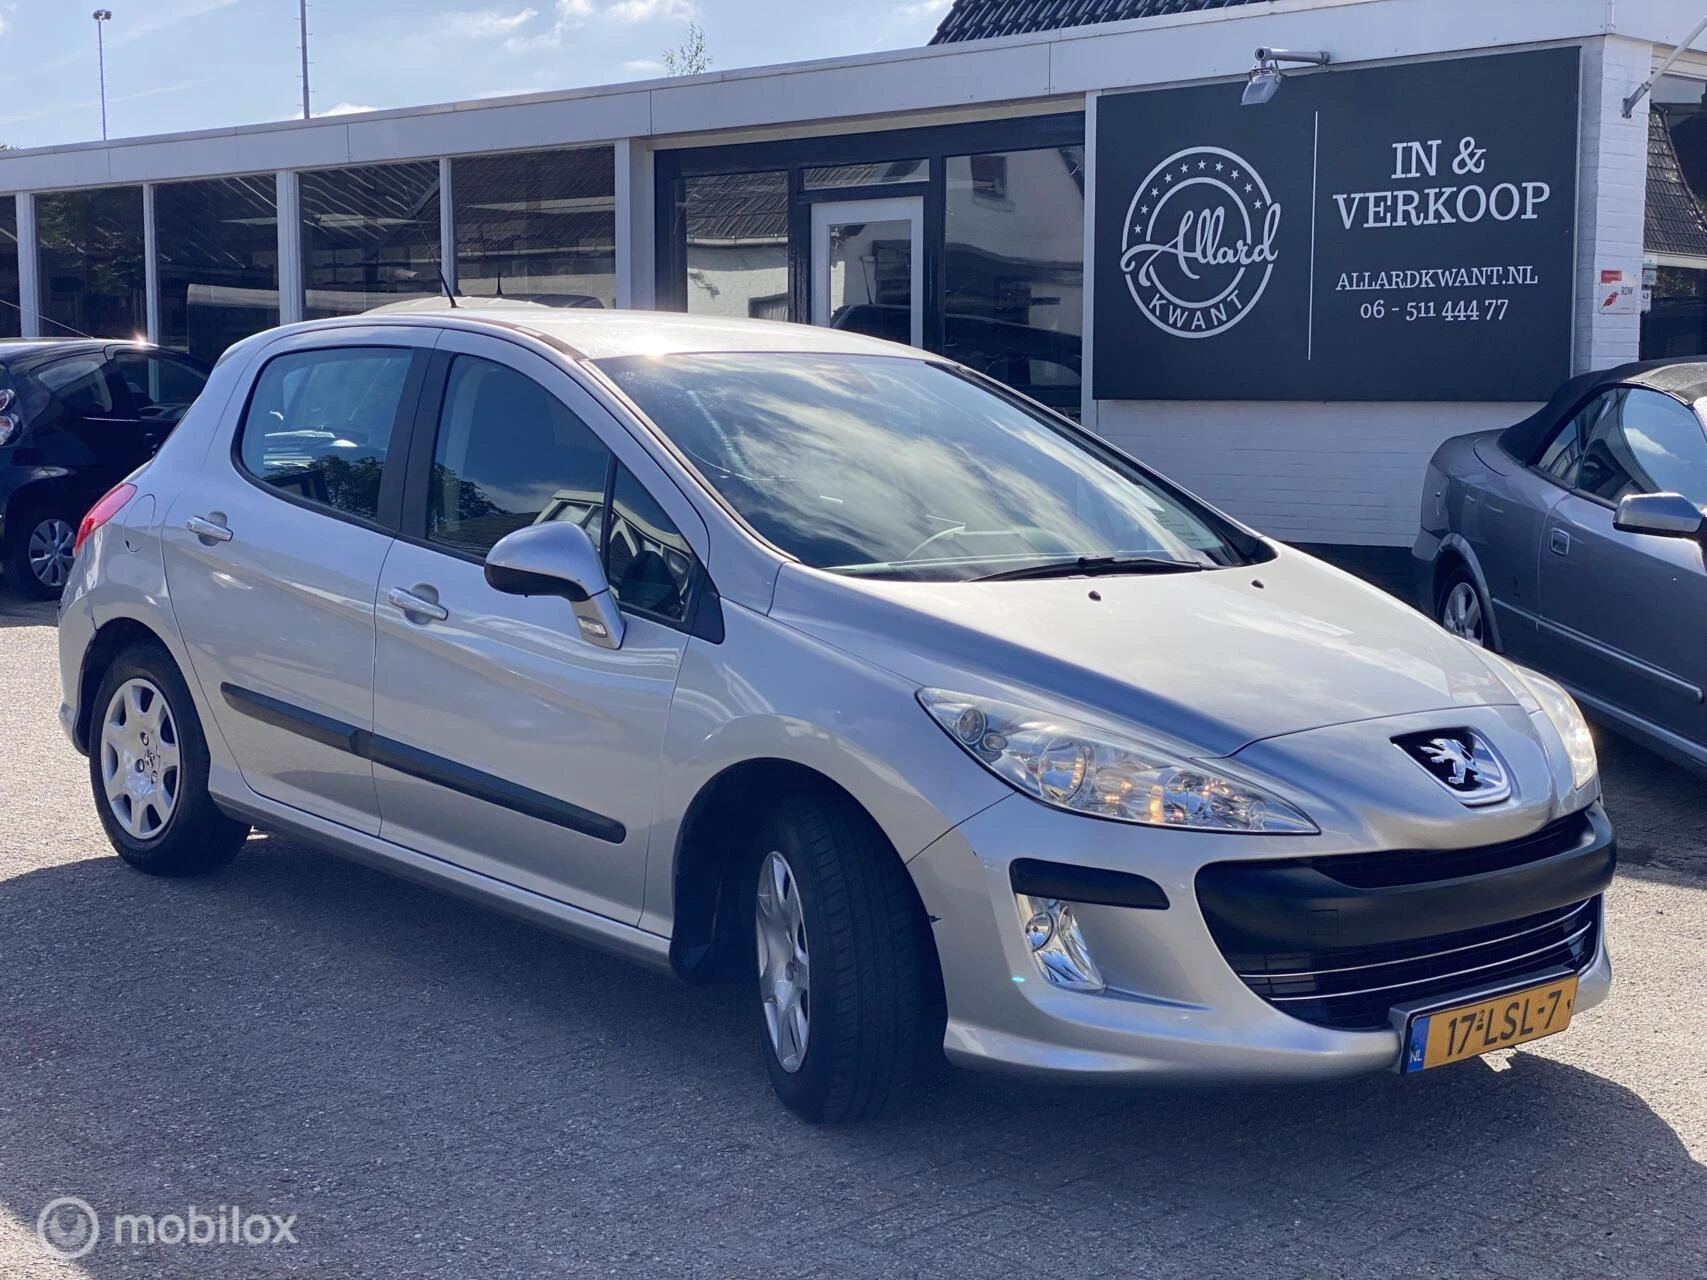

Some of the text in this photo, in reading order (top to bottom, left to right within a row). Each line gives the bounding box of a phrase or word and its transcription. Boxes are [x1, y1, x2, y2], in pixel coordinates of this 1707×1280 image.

[1391, 136, 1487, 179] IN &
[1332, 182, 1550, 230] VERKOOP
[1120, 202, 1281, 287] Allard
[1335, 265, 1538, 290] ALLARDKWANT.NL
[1149, 289, 1242, 330] KWANT
[1360, 299, 1385, 319] 06
[1405, 301, 1437, 321] 511
[1441, 300, 1480, 321] 444
[1485, 299, 1509, 321] 77
[1409, 1050, 1423, 1063] NL
